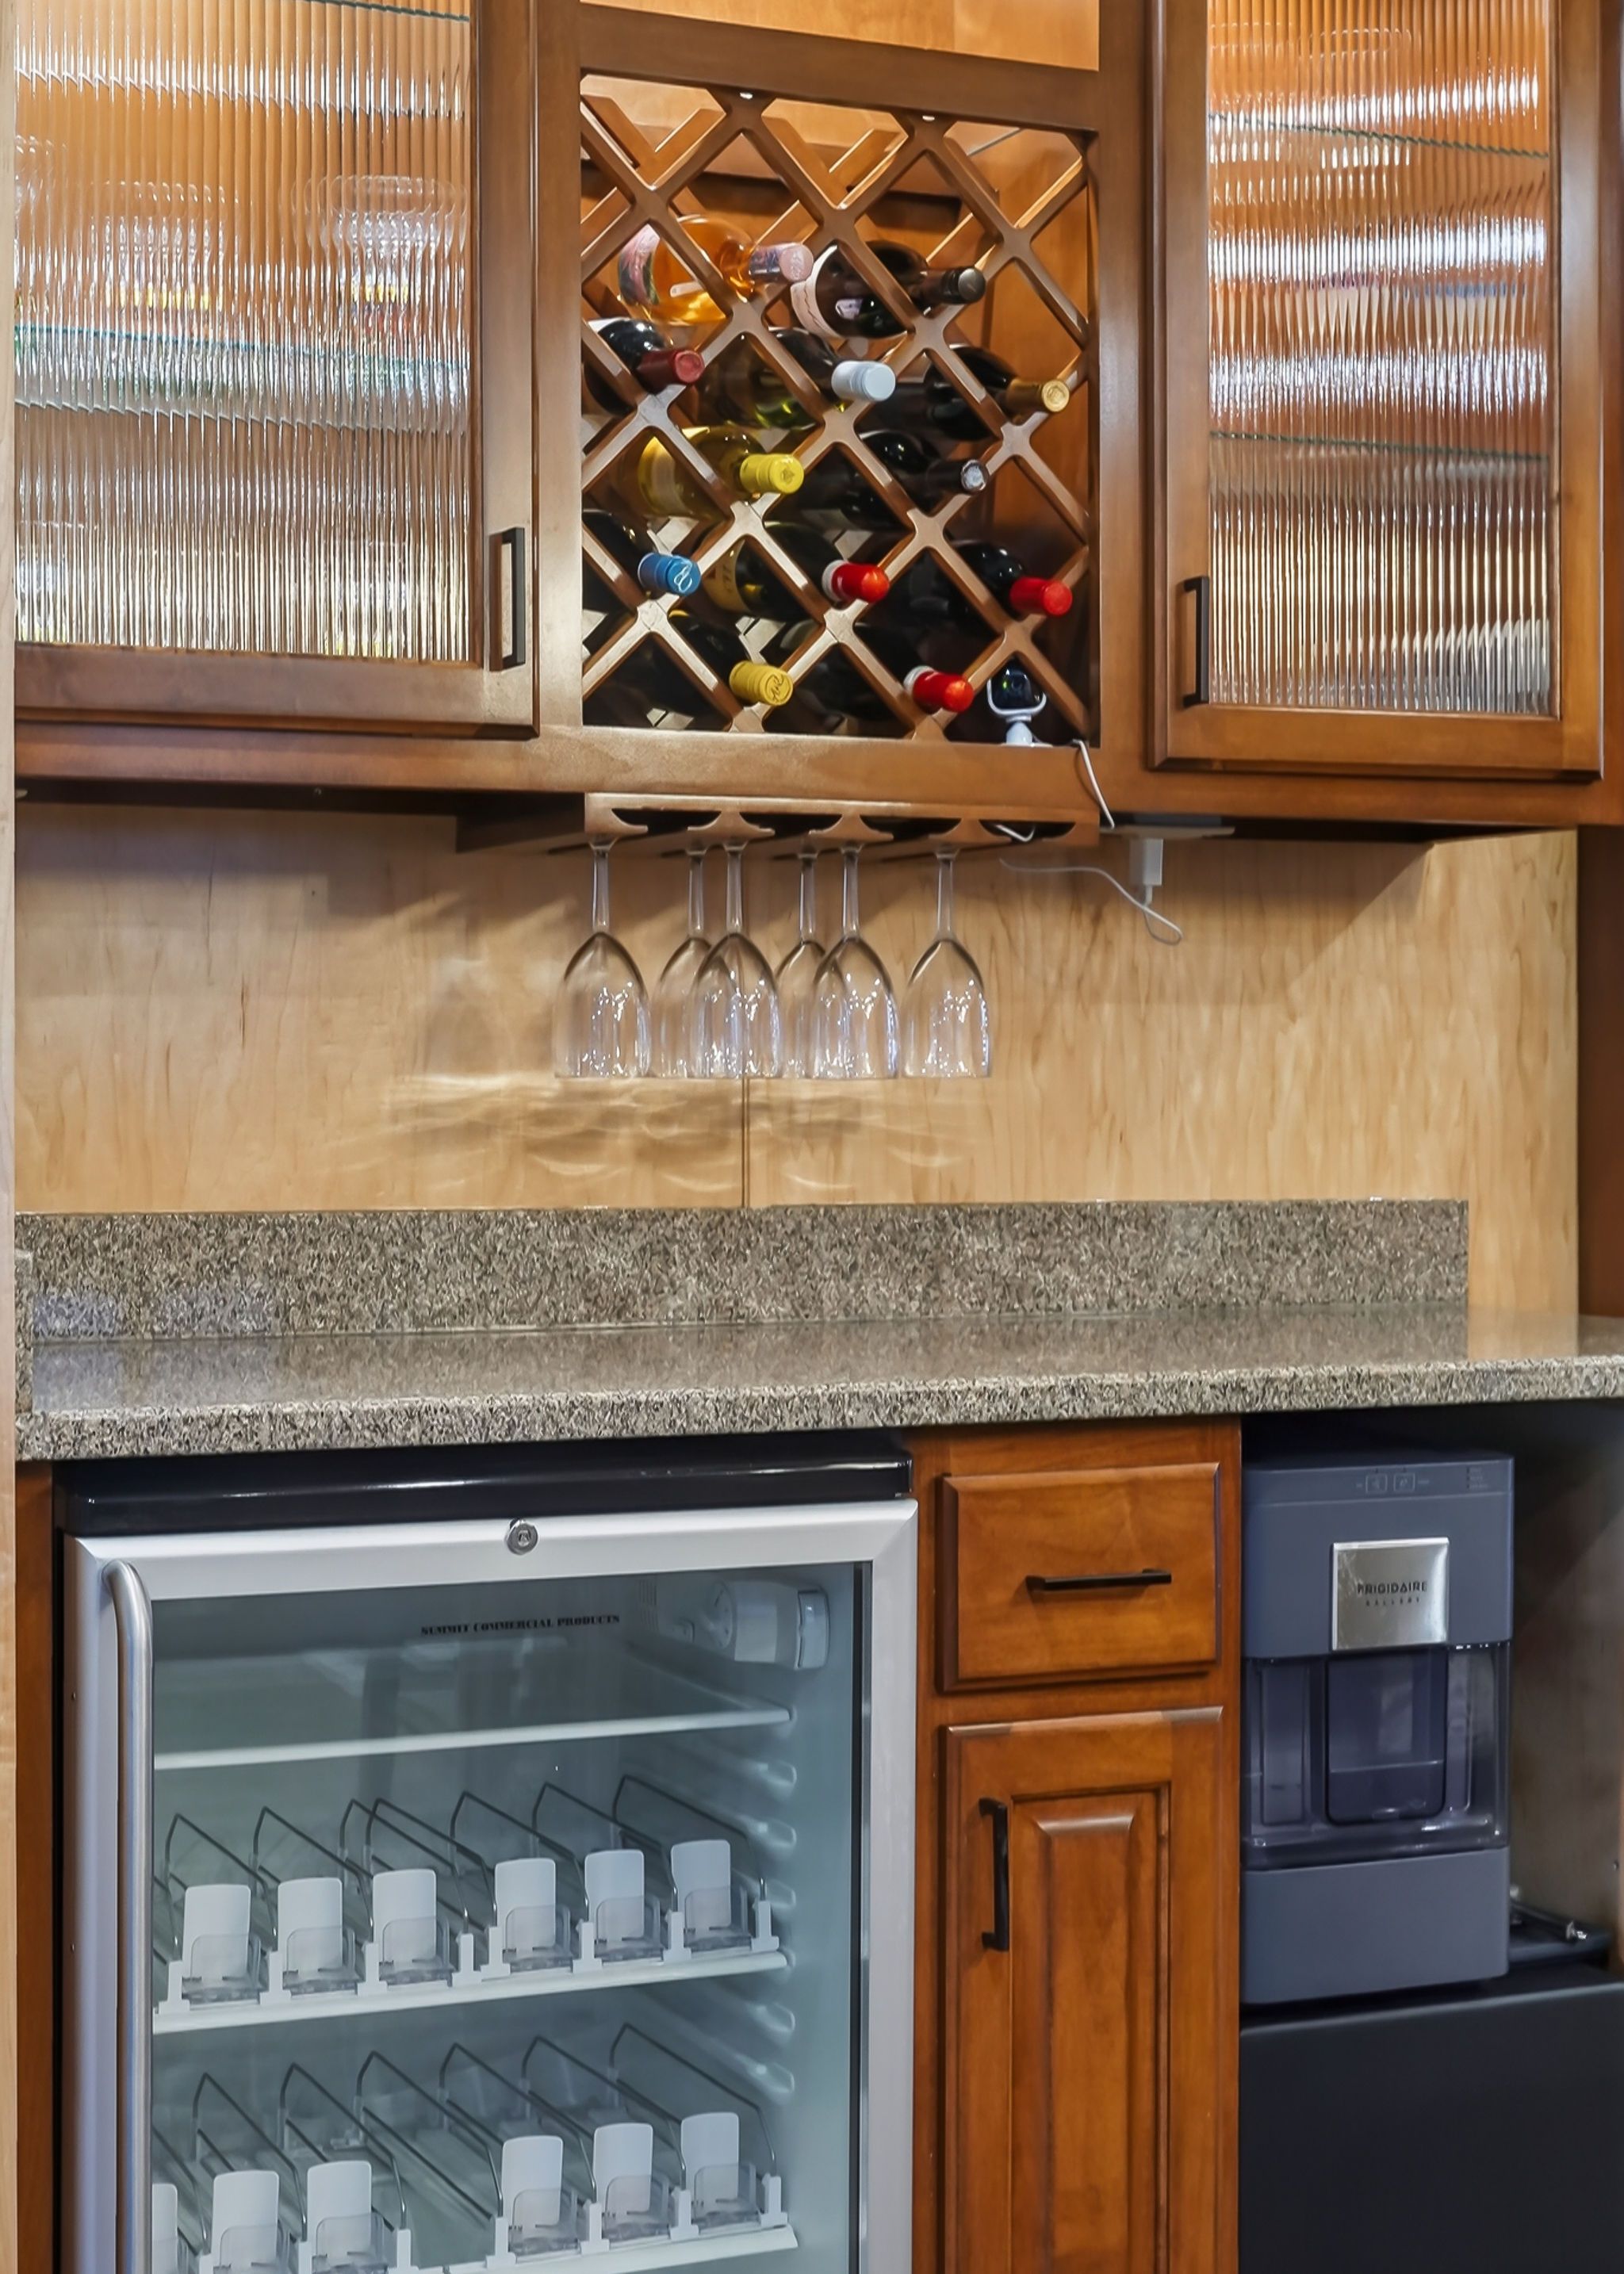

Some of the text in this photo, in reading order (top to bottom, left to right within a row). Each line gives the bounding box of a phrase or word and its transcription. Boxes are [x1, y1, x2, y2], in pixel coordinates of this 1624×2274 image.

[1357, 1581, 1427, 1594] FRIGIDAIRE
[421, 1614, 620, 1636] SUMMIT COMMERCIAL PRODUCTS
